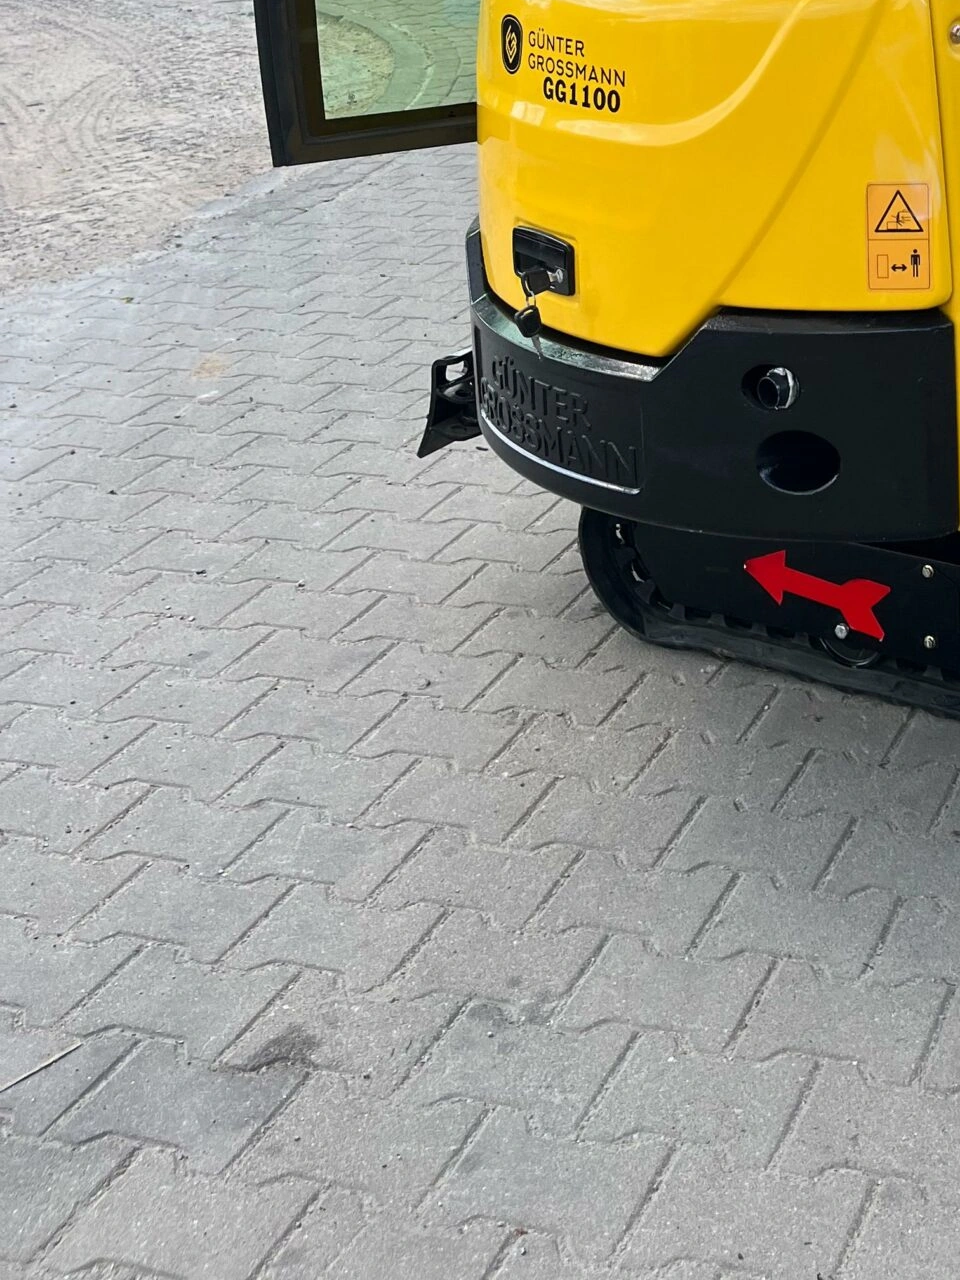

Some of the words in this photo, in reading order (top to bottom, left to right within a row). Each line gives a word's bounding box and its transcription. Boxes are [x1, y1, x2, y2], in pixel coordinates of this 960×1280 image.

[528, 28, 585, 57] GÜNTER
[527, 52, 626, 88] GROSSMANN
[543, 76, 621, 113] GG1100
